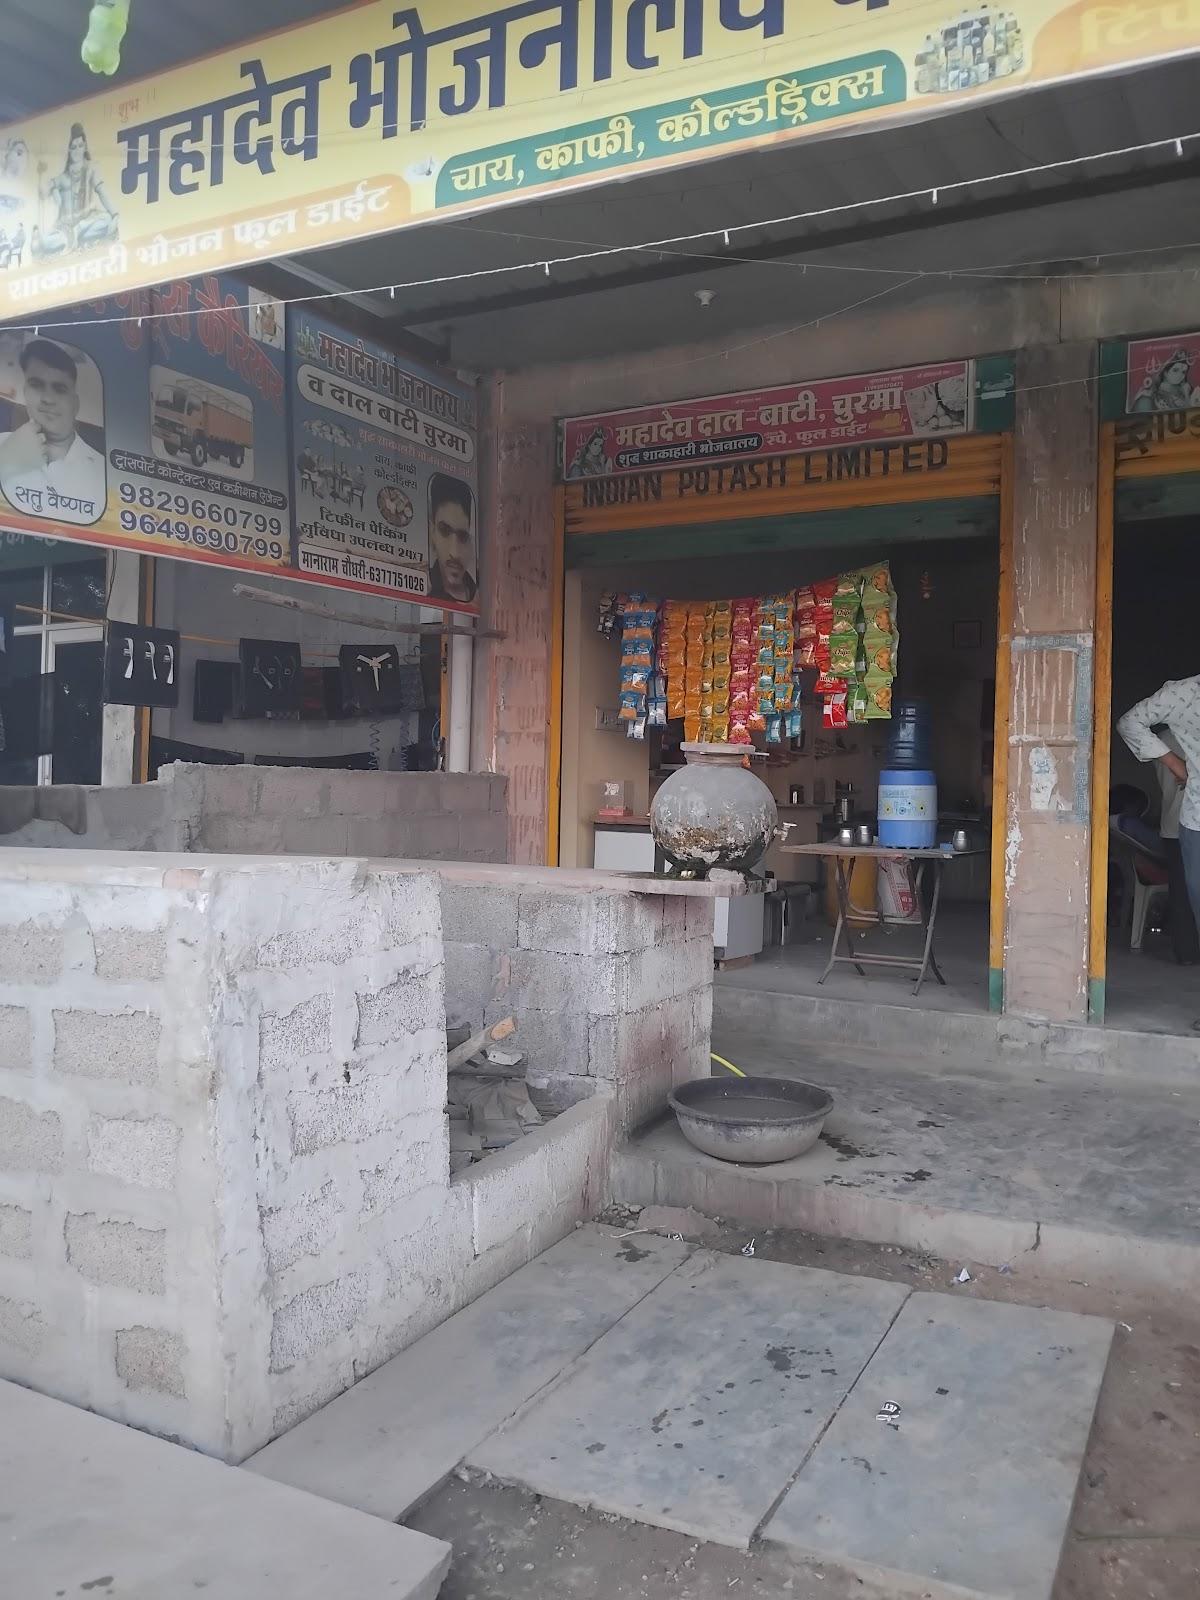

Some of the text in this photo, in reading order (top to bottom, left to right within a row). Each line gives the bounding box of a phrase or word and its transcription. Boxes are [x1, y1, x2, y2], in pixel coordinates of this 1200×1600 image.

[117, 59, 331, 204] महादेव
[535, 115, 645, 171] काफी,
[136, 228, 224, 266] भोजन
[307, 374, 467, 454] व दाल बाटी चुरमा
[615, 410, 694, 448] महादेव
[832, 388, 904, 424] चुरमा
[582, 438, 948, 507] INDIAN POTASH LIMITED
[642, 443, 696, 461] शाकाहारी
[699, 437, 760, 454] भोजनालय
[46, 485, 95, 516] वैष्णव
[119, 482, 282, 536] 9829660799
[120, 510, 284, 560] 9649690799
[302, 550, 339, 574] मानाराम
